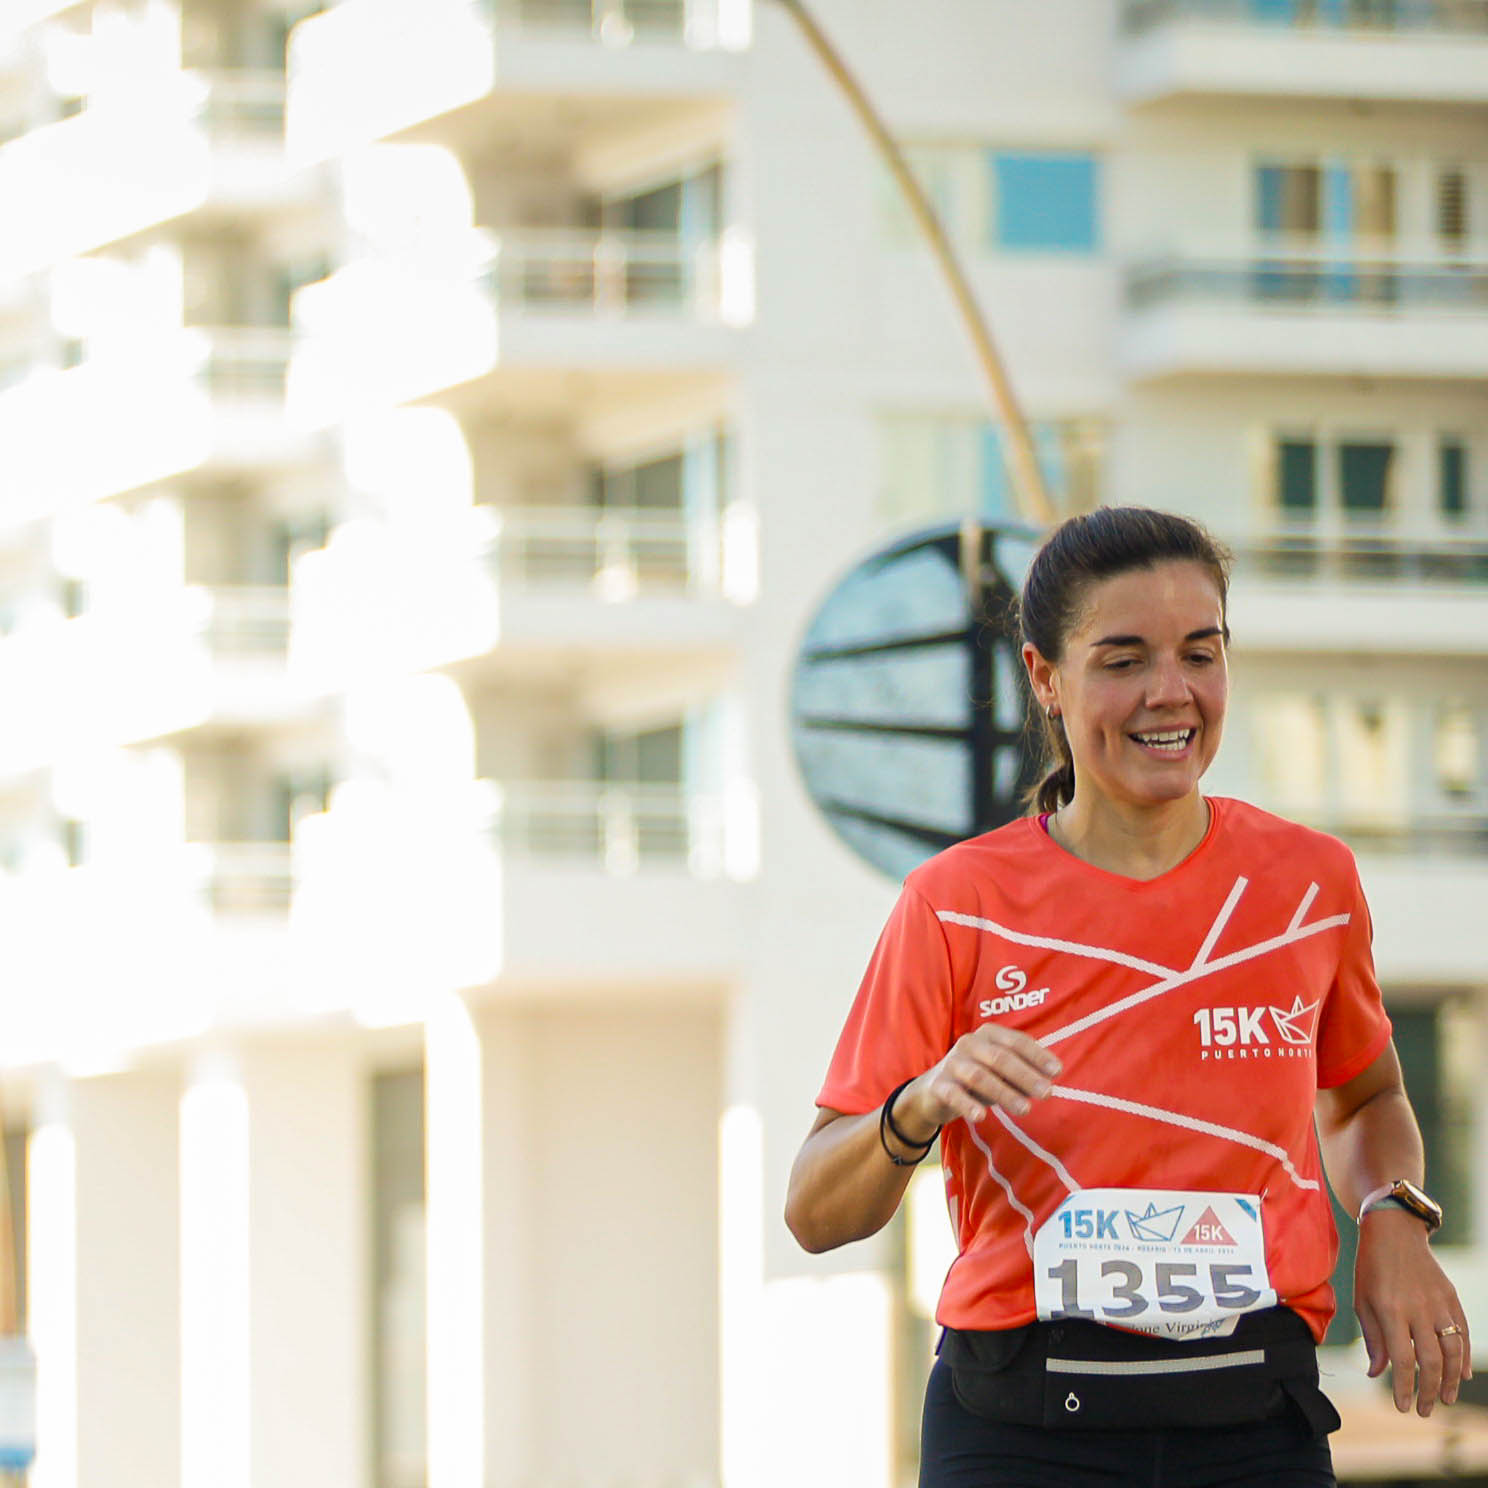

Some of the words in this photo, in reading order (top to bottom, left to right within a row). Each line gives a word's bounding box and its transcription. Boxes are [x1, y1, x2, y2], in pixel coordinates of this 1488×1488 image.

[1193, 1007, 1270, 1046] 15K
[1201, 1048, 1271, 1060] PUERTO
[1058, 1209, 1120, 1240] 15K
[1193, 1225, 1224, 1241] 15K
[1048, 1259, 1261, 1320] 1355
